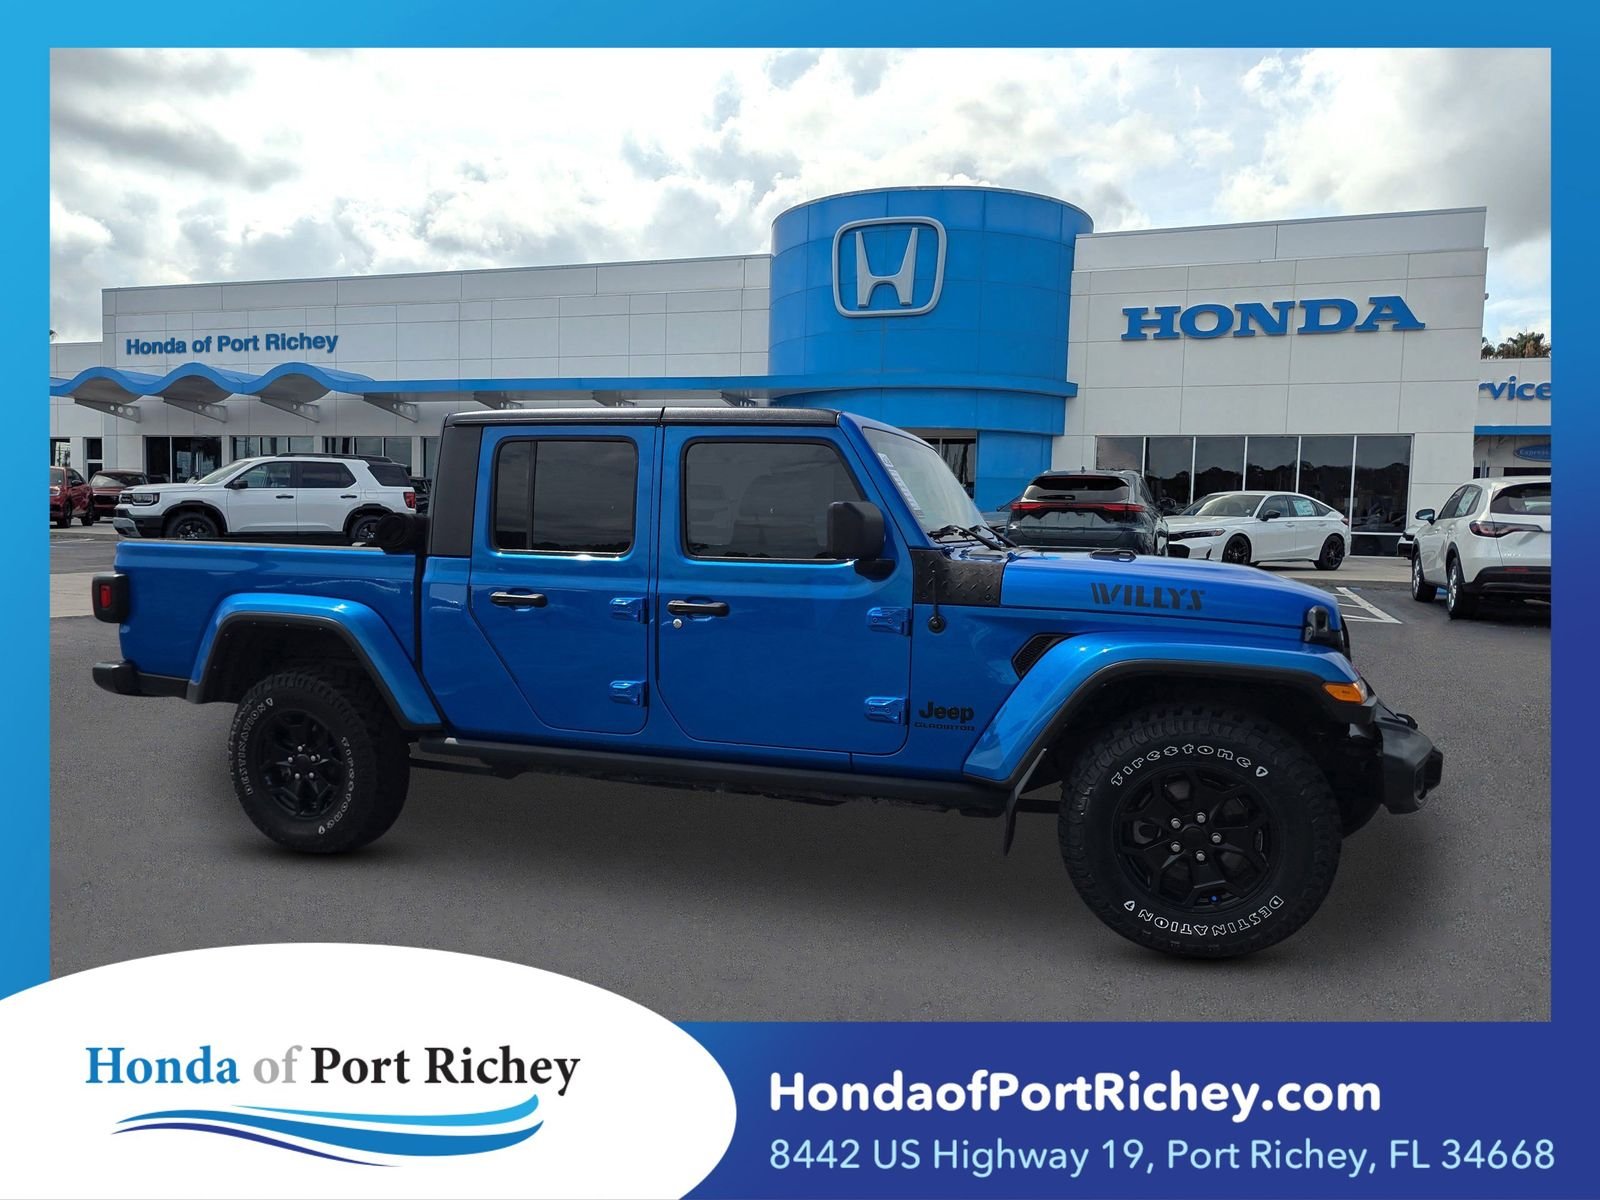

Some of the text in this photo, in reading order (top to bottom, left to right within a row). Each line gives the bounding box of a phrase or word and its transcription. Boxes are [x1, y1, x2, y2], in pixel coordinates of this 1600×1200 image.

[1121, 295, 1426, 341] HONDA
[125, 332, 339, 355] Honda of Port Richey
[1091, 582, 1206, 611] WILLYS
[914, 722, 976, 731] GLADIATOR
[919, 700, 974, 724] Jeep
[1110, 743, 1252, 787] Firestone
[1138, 895, 1285, 937] DESTINATION
